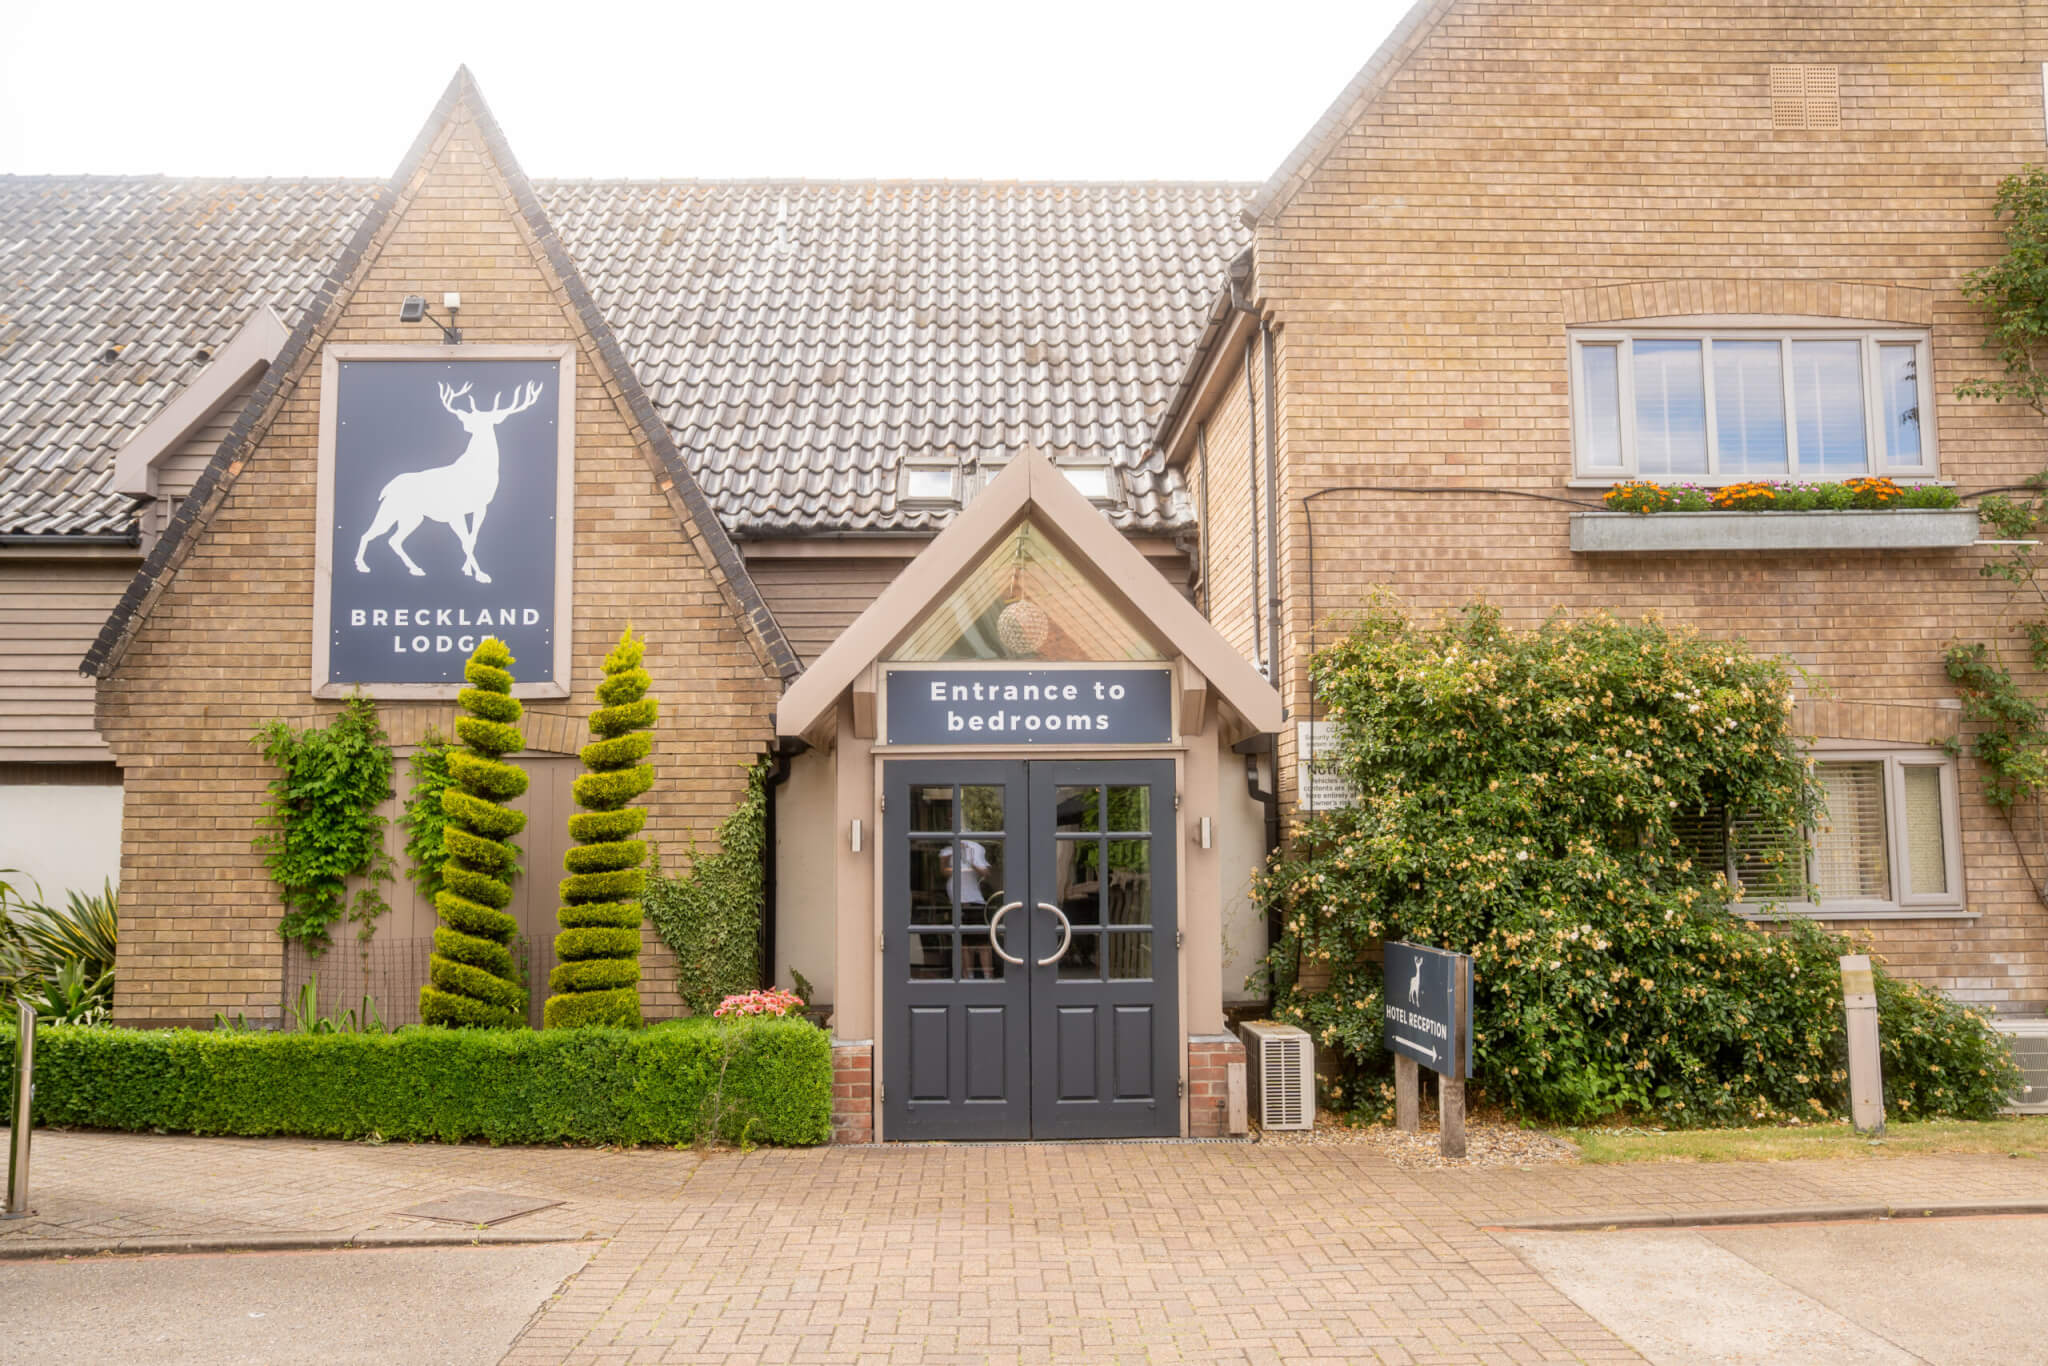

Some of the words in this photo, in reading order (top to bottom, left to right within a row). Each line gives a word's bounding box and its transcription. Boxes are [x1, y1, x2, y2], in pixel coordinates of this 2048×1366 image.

[351, 608, 540, 626] BRECKLAND
[394, 635, 495, 653] LODG
[930, 681, 1078, 701] Entrance
[1093, 682, 1126, 700] to
[947, 711, 1110, 731] bedrooms
[1386, 1004, 1408, 1025] HOTEL
[1409, 1012, 1447, 1041] RECEPTION
